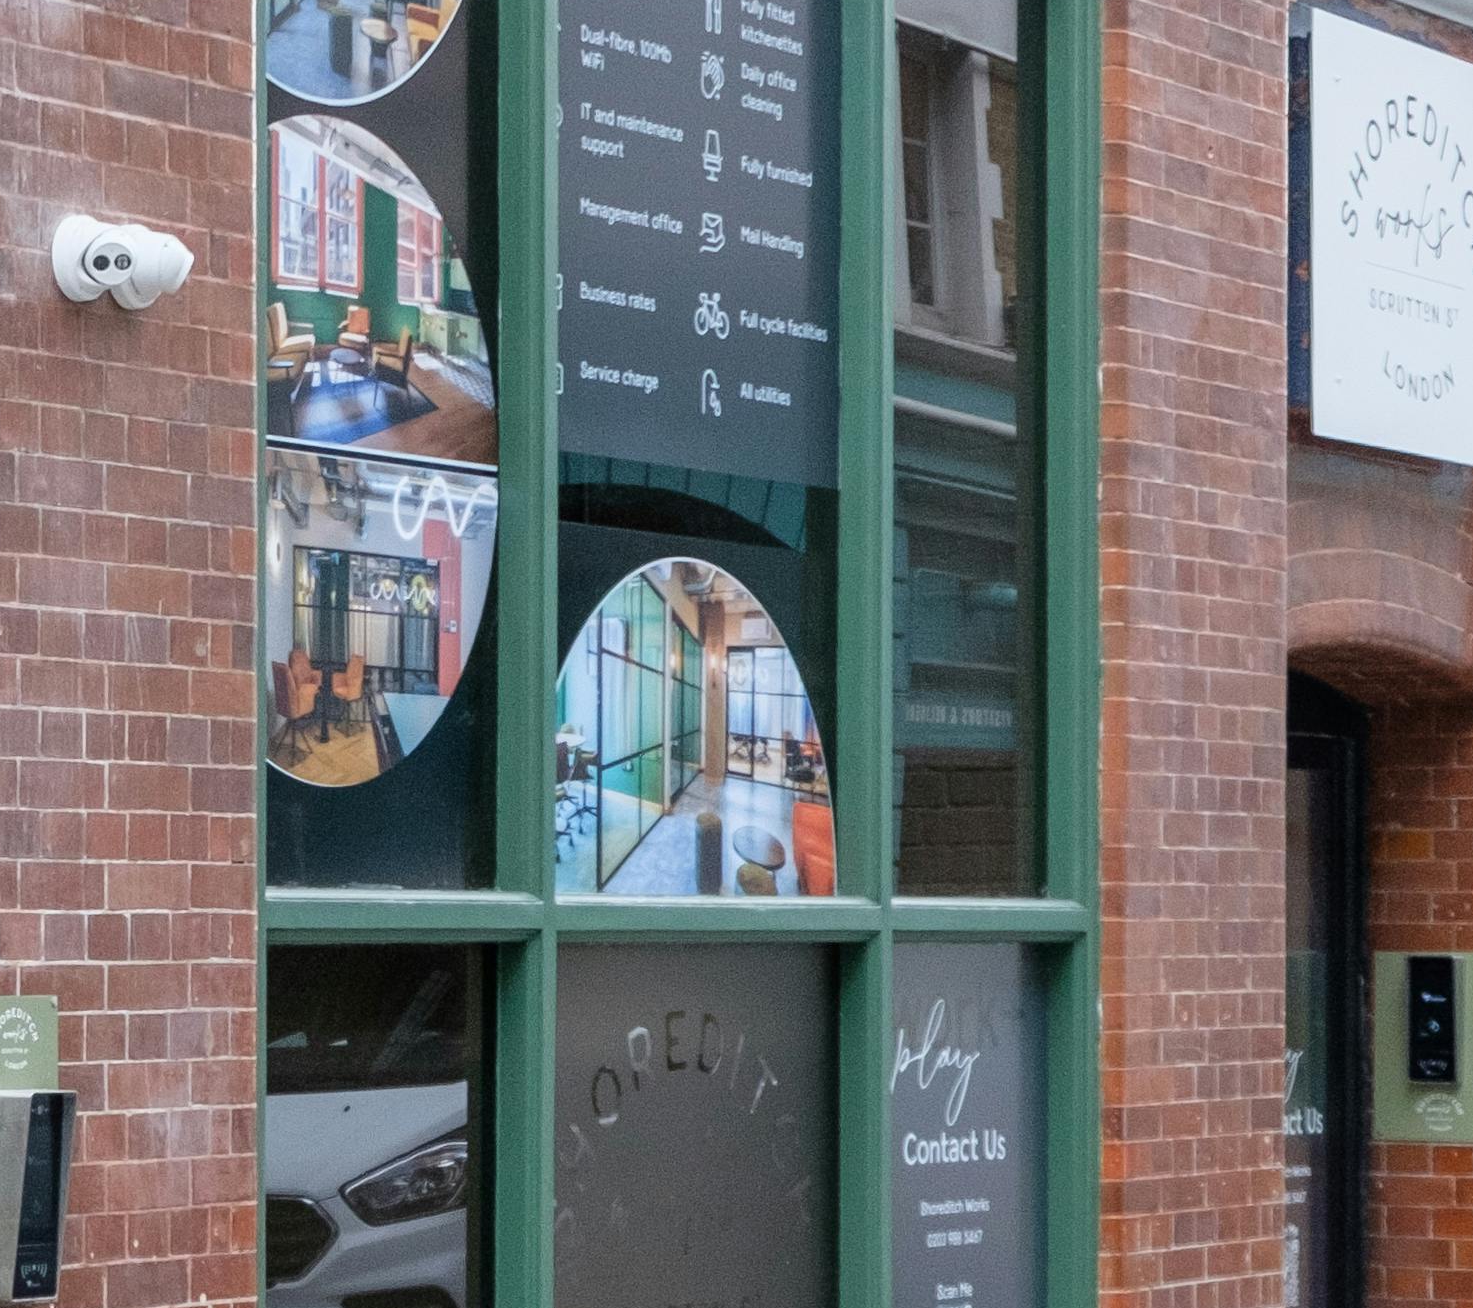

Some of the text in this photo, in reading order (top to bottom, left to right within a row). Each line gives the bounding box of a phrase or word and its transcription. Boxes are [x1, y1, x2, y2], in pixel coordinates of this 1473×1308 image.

[580, 102, 684, 142] IT and maintenance
[581, 135, 624, 158] support
[580, 197, 683, 234] Management office
[580, 281, 656, 312] Business rates
[1369, 288, 1440, 324] SCRUTTON
[580, 360, 659, 394] Service charge
[1383, 350, 1455, 402] LONDON
[891, 999, 980, 1126] play
[1306, 1106, 1324, 1134] Us
[904, 1129, 1006, 1165] Contact Us
